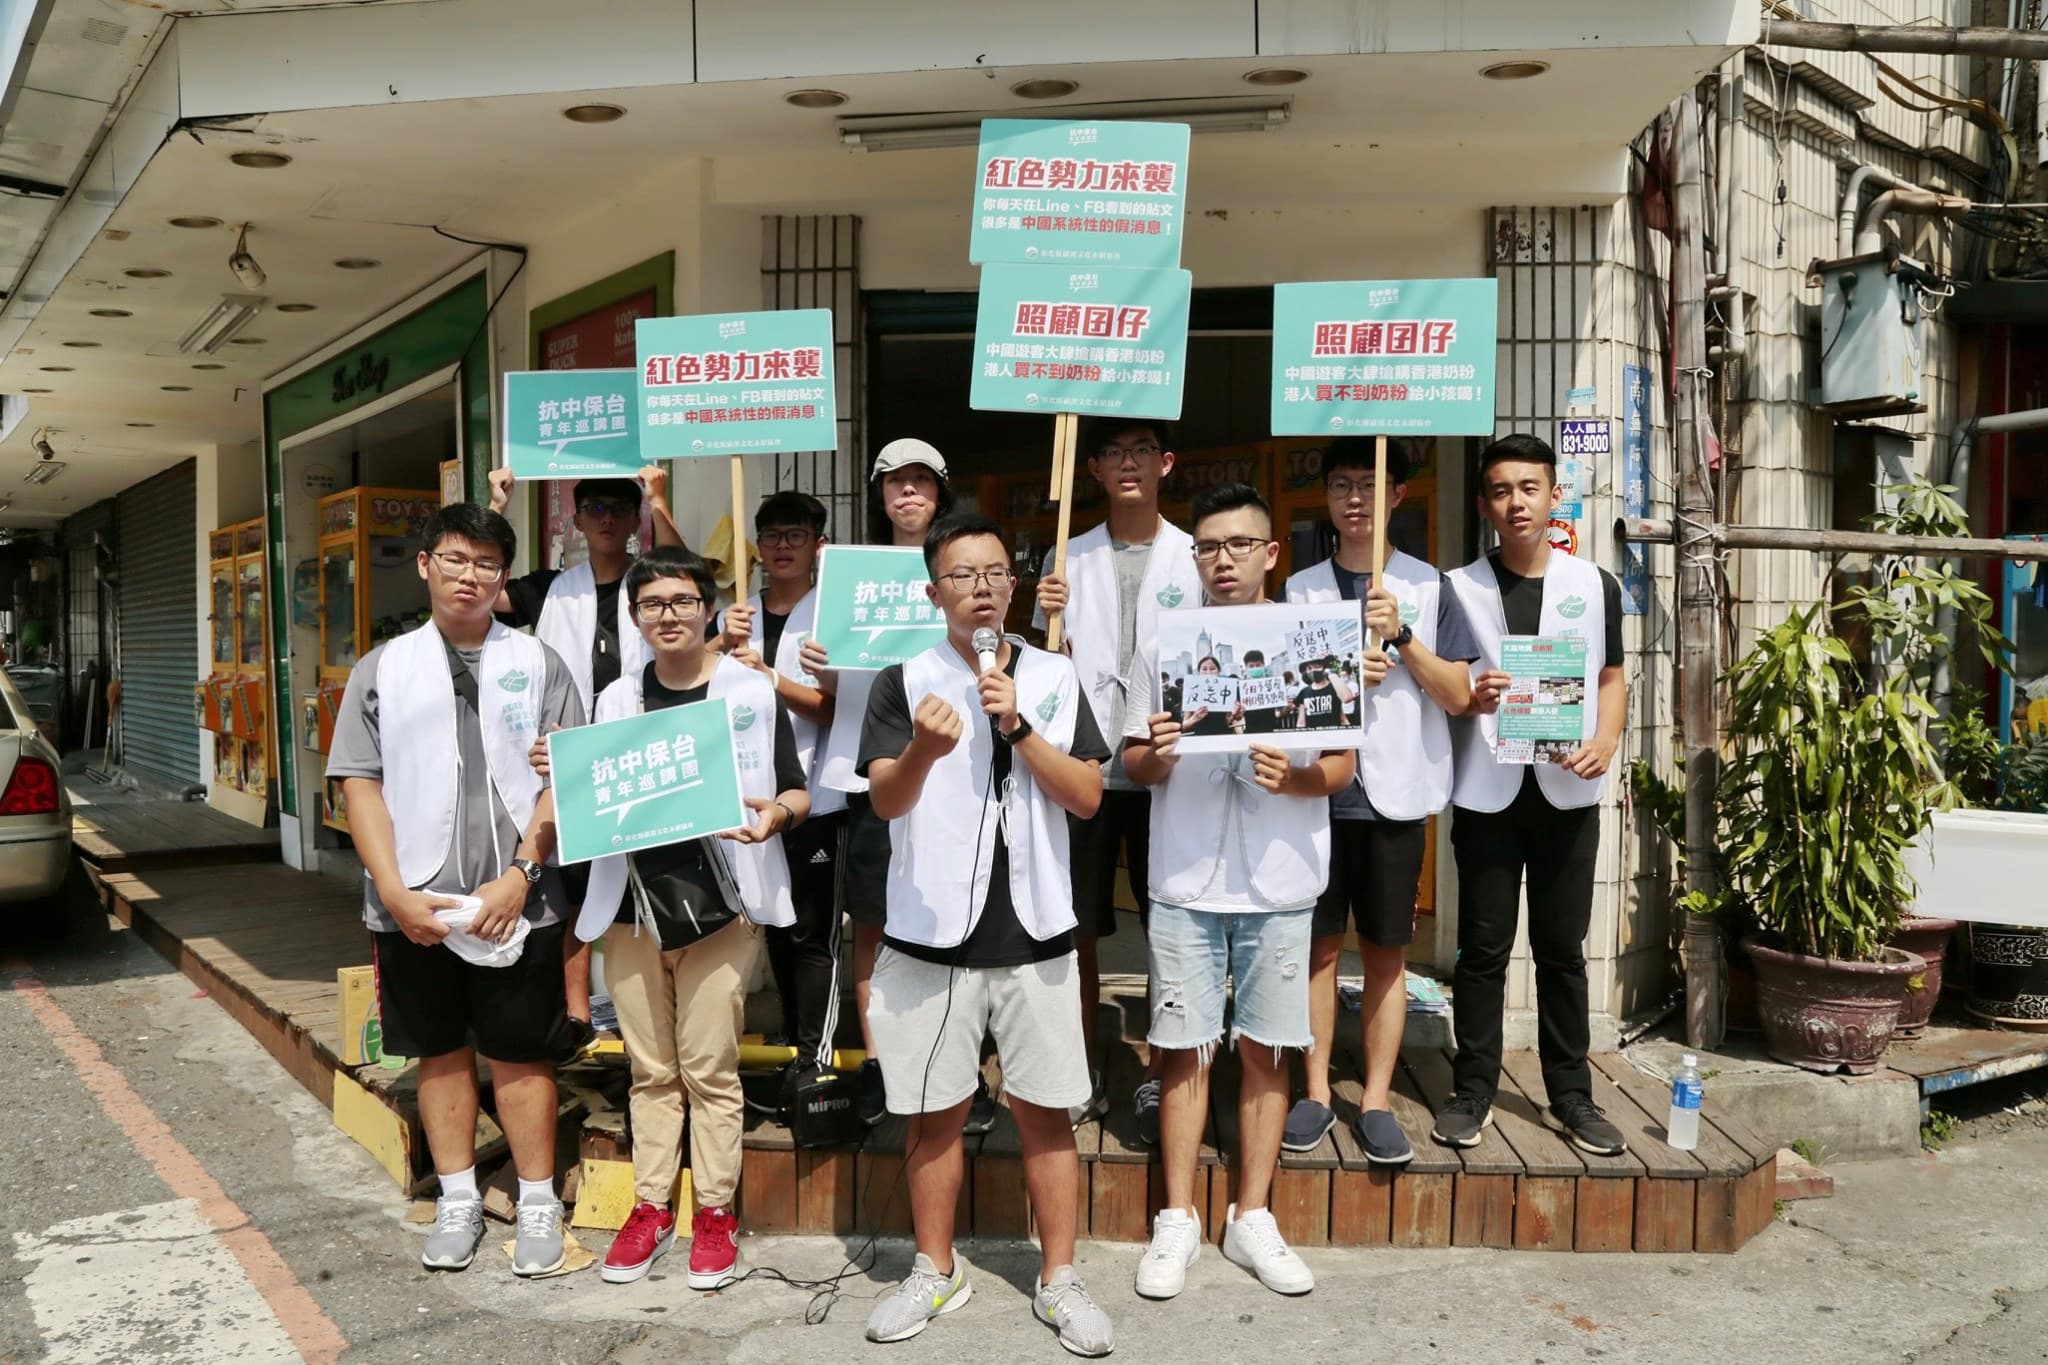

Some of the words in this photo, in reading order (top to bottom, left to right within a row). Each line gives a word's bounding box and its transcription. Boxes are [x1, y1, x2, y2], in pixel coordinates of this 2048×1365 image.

[984, 158, 1175, 193] 紅色勢力來襲
[983, 198, 1174, 216] 你每天在Line、FB看到的貼文
[981, 216, 1172, 235] 很多是中國系統性的假消息！
[1013, 302, 1150, 340] 照顧囝仔
[1312, 320, 1456, 357] 照顧囝仔
[986, 343, 1165, 365] 中國遊客大肆搶購香港奶粉
[644, 348, 824, 387] 紅色勢力來襲
[984, 362, 1170, 385] 港人買不到奶粉給小孩喝！
[1285, 365, 1475, 381] 中國遊客大肆搶購香港奶粉
[647, 387, 825, 408] 你每天在Line、FB看到的貼文
[1284, 384, 1482, 402] 港人買不到奶粉給小孩喝！
[538, 393, 625, 422] 抗中保台
[647, 405, 824, 426] 很多是中國系統性的假消息！
[539, 416, 626, 438] 青年巡講團
[1562, 422, 1608, 434] 人人搬家
[1562, 434, 1609, 453] 831-9000
[1629, 375, 1646, 578] 南無阿彌佛
[854, 580, 930, 605] 抗中保
[591, 734, 696, 787] 抗中保台
[595, 759, 699, 806] 青年巡講團
